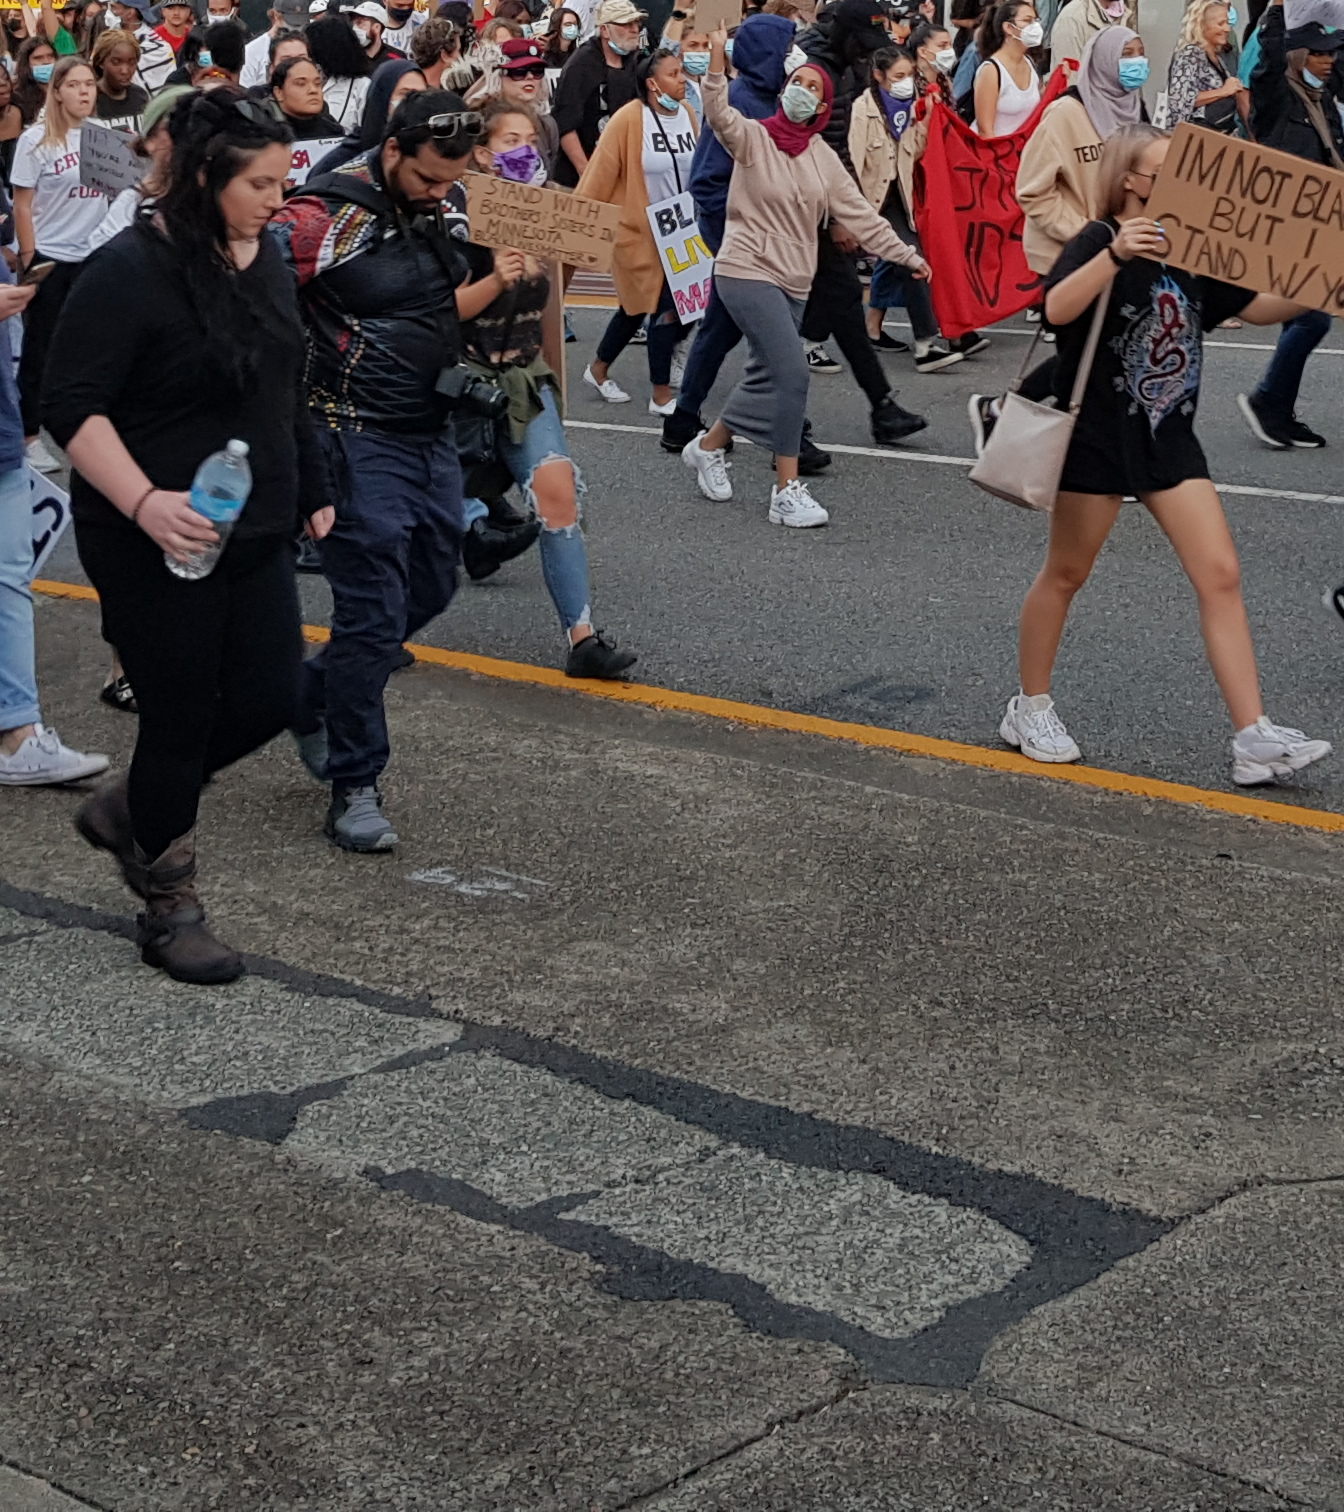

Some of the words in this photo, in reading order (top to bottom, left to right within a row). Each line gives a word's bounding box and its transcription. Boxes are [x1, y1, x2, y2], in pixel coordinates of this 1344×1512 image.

[1175, 132, 1228, 192] IM
[1225, 149, 1293, 209] NOT
[484, 178, 544, 204] STAND
[553, 193, 601, 220] WITH
[485, 218, 565, 245] MINNESOTA
[548, 213, 596, 238] SISTERS
[1152, 212, 1248, 282] STAND
[1208, 196, 1285, 246] BUT
[1303, 228, 1319, 259] I
